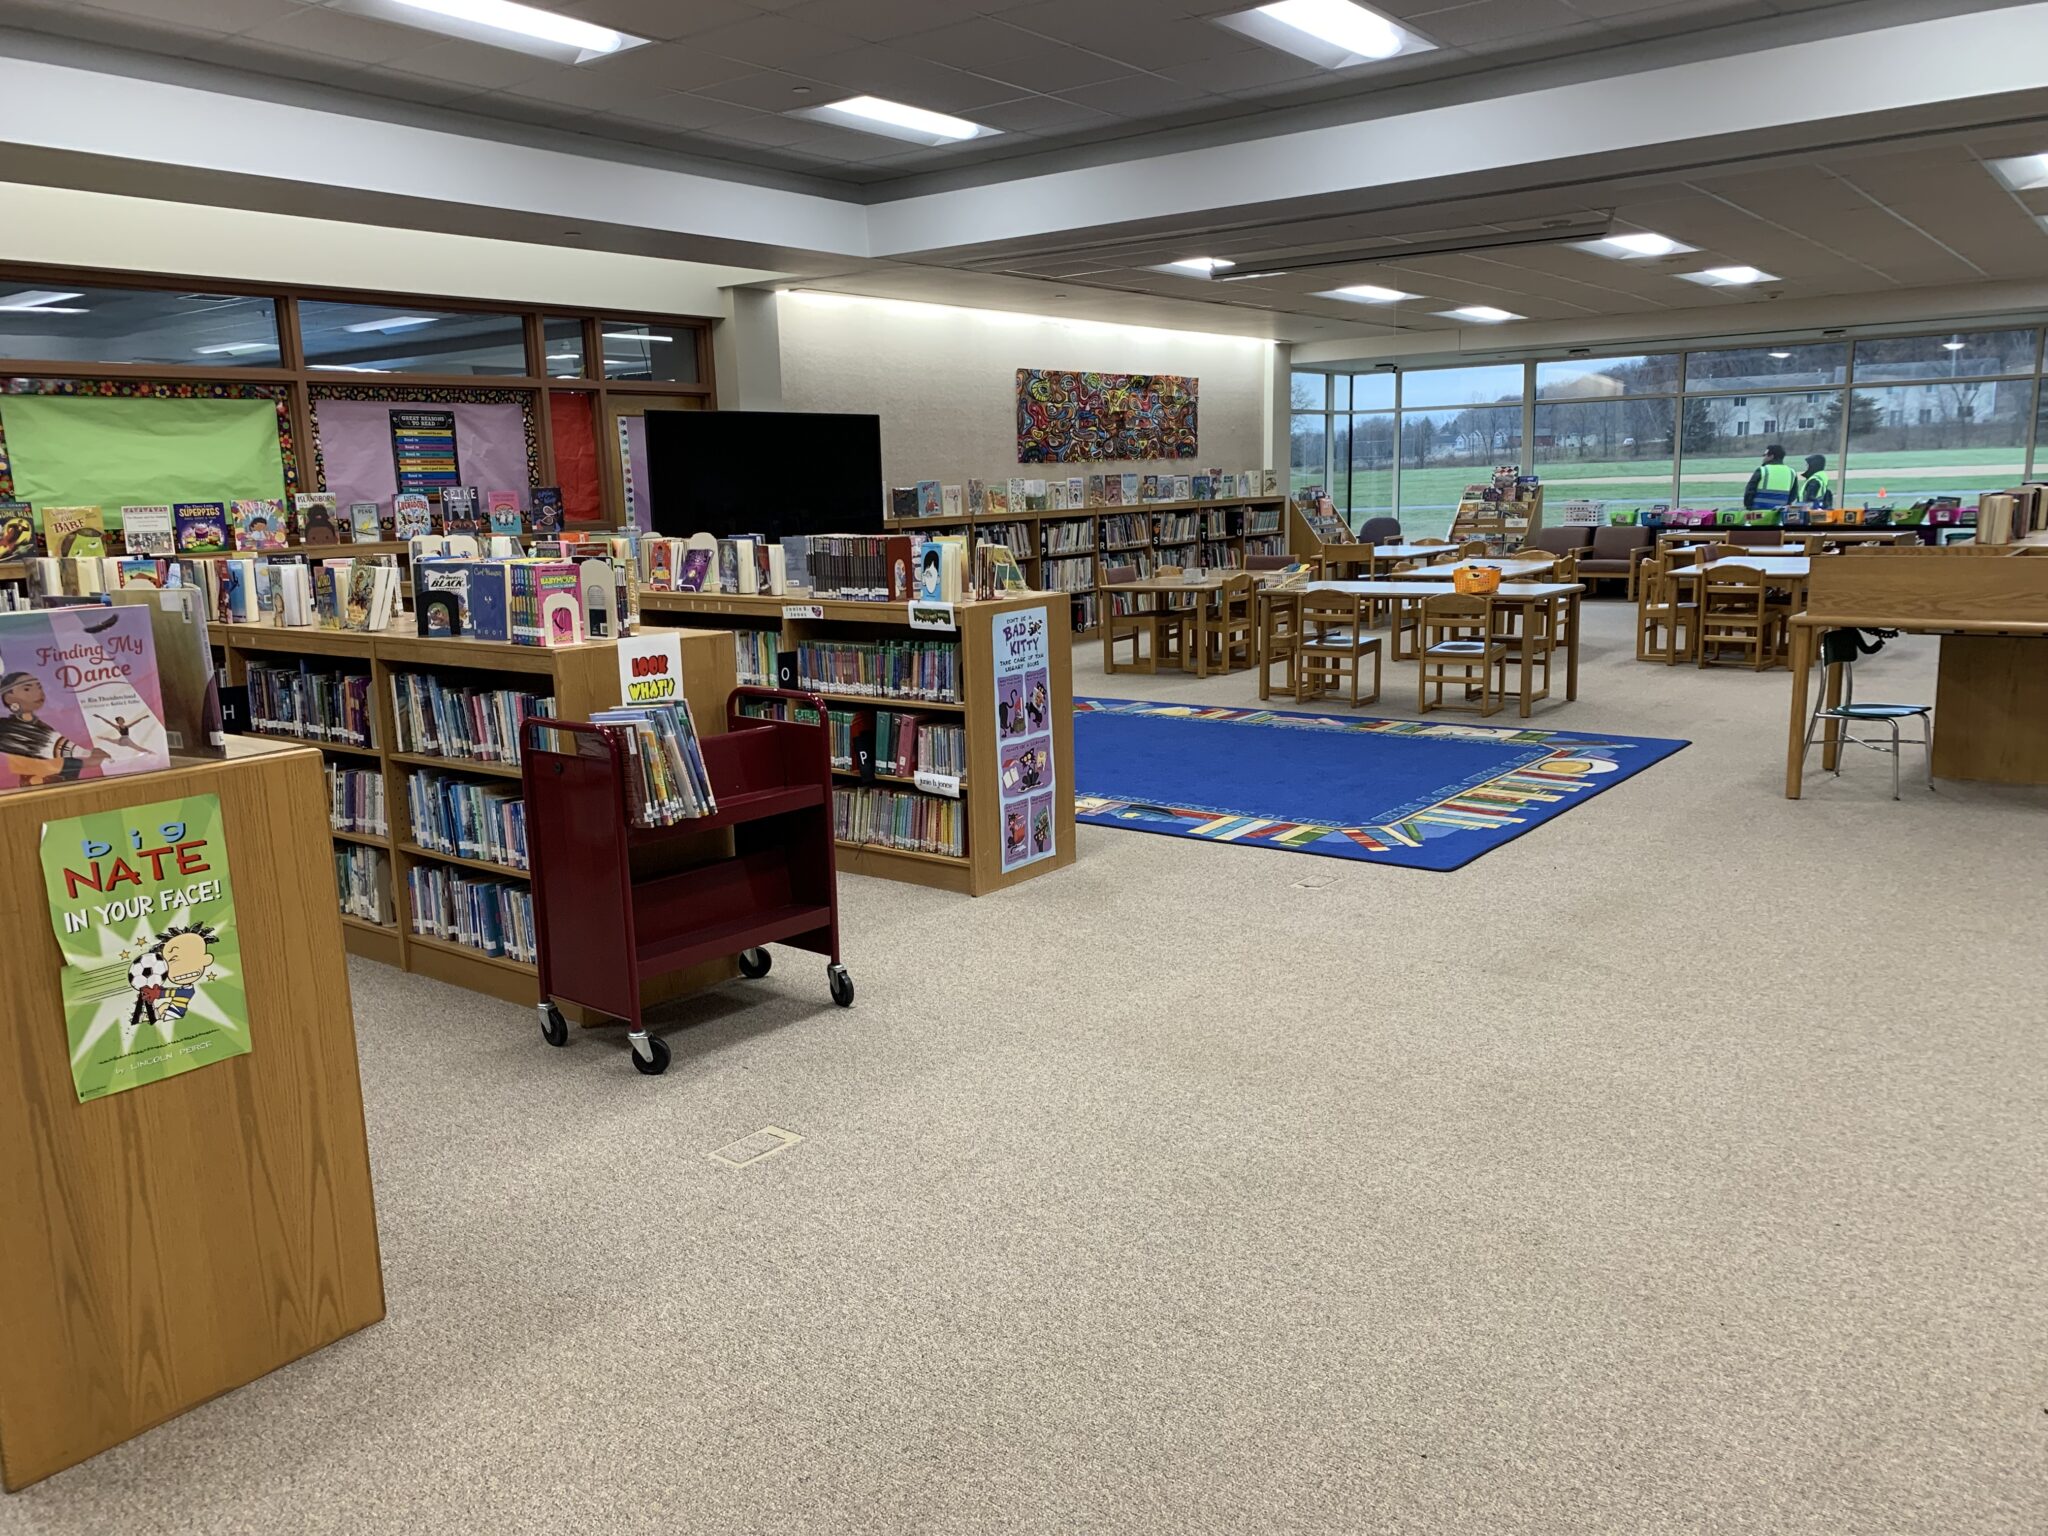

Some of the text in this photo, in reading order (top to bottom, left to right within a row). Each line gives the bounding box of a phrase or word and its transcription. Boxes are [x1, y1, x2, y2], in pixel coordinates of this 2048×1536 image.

[443, 488, 477, 501] SPIKE
[179, 507, 220, 517] SUPERPIGS
[52, 518, 85, 534] BARF
[1099, 541, 1106, 550] R
[1153, 536, 1159, 544] S
[1041, 547, 1047, 555] P
[430, 580, 463, 588] BLACK
[1003, 622, 1027, 642] BAD
[1077, 623, 1083, 633] Q
[36, 634, 144, 666] Finding My
[1009, 637, 1040, 656] KITTY
[632, 654, 669, 677] LOOK
[55, 662, 132, 689] Dance
[781, 667, 790, 681] O
[222, 704, 236, 720] H
[859, 751, 868, 765] P
[80, 821, 187, 859] big
[63, 839, 211, 899] NATE
[63, 879, 222, 934] IN YOUR FACE!
[130, 1052, 174, 1070] LINCOLN
